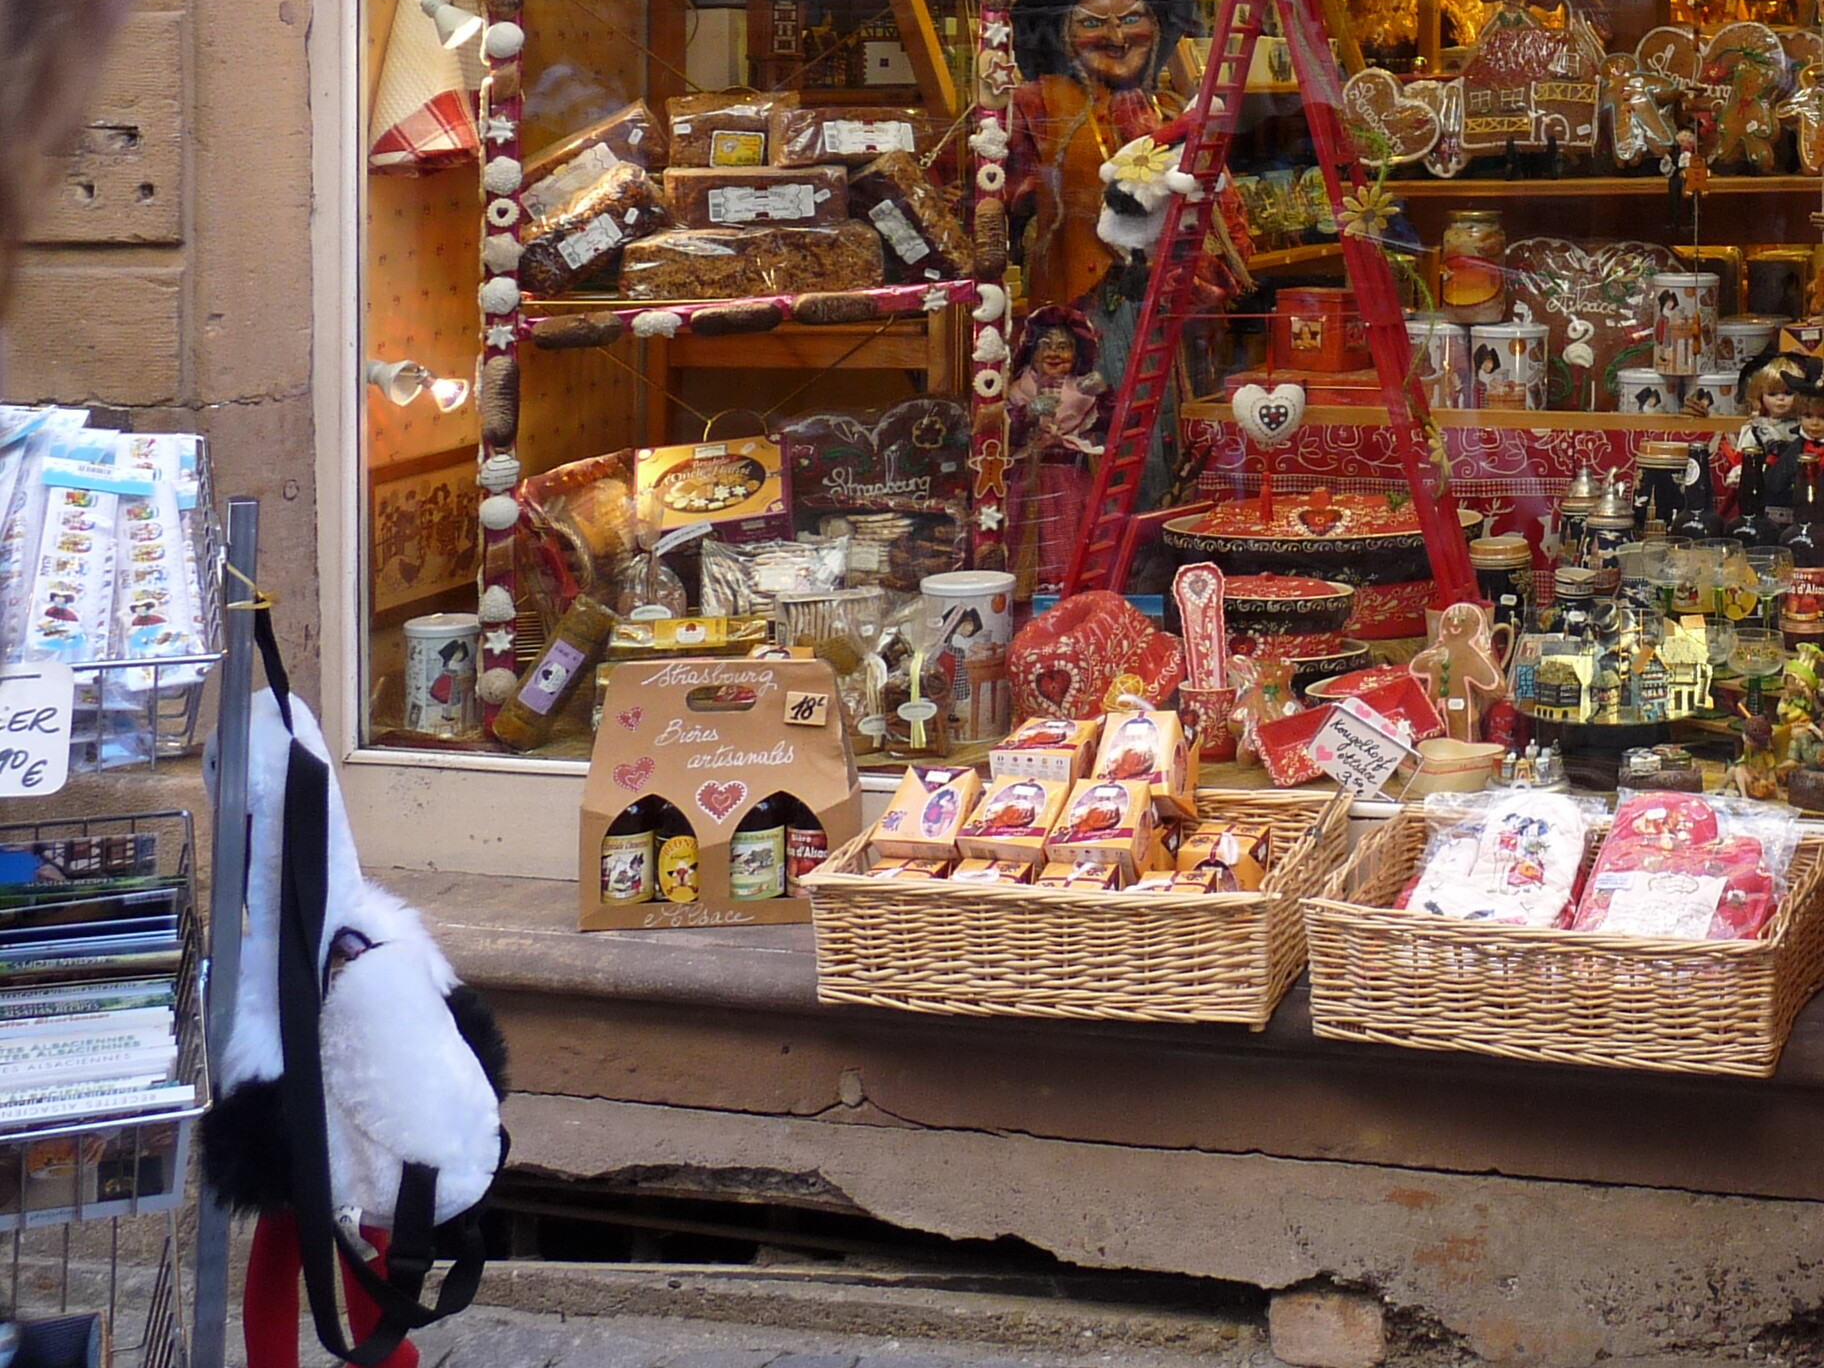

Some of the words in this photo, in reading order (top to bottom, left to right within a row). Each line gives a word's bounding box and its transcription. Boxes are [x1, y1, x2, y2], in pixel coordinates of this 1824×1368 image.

[641, 663, 778, 691] Strasbourg
[655, 719, 719, 746] Bières
[686, 740, 795, 769] artisanales
